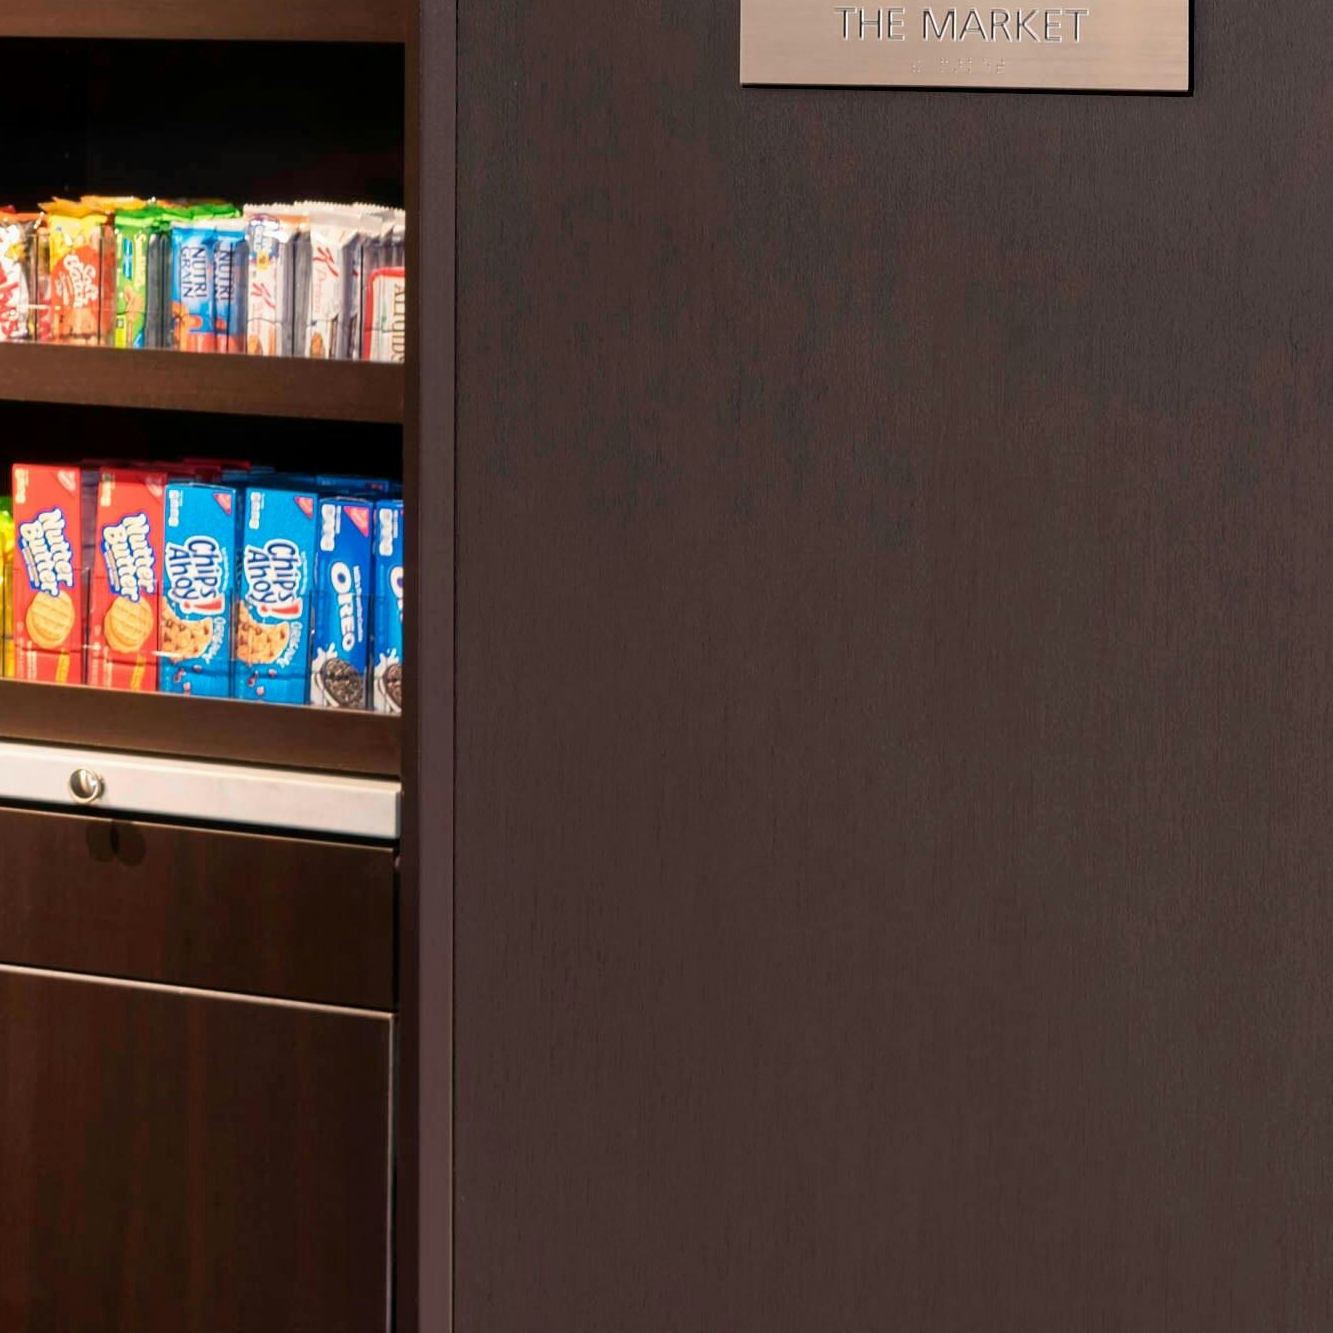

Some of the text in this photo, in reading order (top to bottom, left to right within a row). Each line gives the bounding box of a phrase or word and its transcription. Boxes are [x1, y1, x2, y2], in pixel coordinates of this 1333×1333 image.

[835, 6, 1090, 44] THE MARKET
[181, 246, 195, 299] GRAIN
[192, 246, 208, 299] NUTRI
[20, 521, 60, 597] Butter
[38, 508, 74, 587] Nutter
[103, 525, 140, 602] Butter
[122, 513, 155, 594] Nutter
[188, 538, 219, 600] Chips
[267, 542, 299, 604] Chips
[331, 561, 355, 652] OREO
